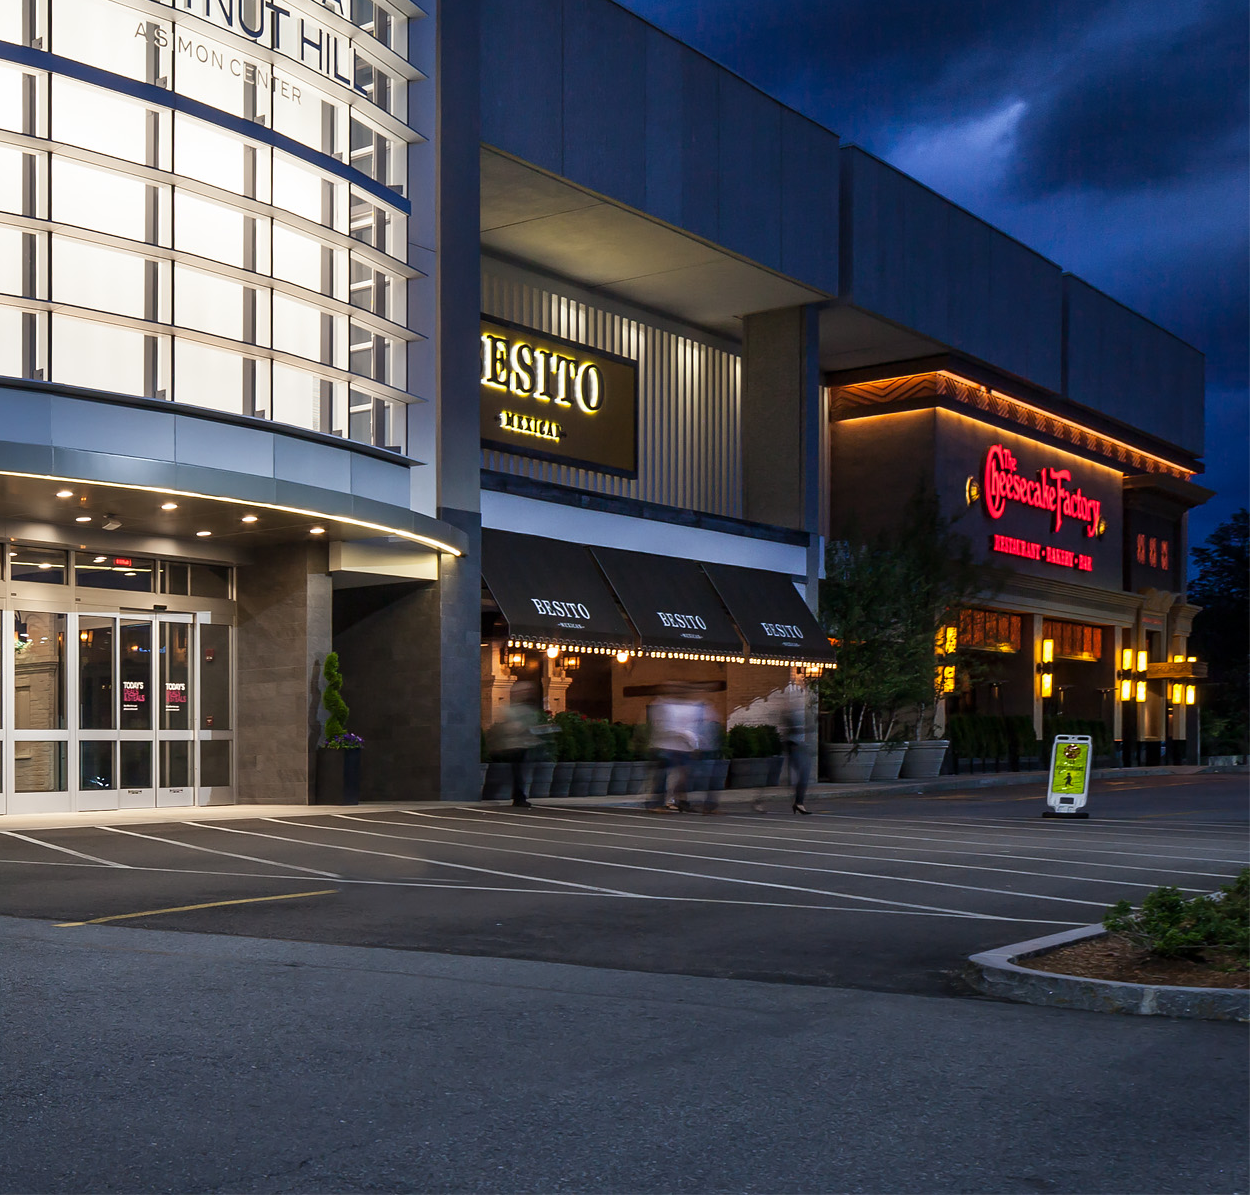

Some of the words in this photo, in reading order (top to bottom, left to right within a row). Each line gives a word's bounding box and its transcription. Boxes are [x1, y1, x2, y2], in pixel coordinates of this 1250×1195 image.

[135, 22, 148, 42] A
[230, 59, 301, 105] CENTER
[300, 18, 368, 97] HILL
[480, 333, 605, 413] ESITO
[984, 444, 1056, 519] Cheesecake
[1049, 467, 1101, 538] Factory
[993, 534, 1041, 560] RESTAURANT
[530, 598, 591, 620] BESITO
[656, 612, 707, 631] BESITO
[761, 622, 804, 639] BESITO
